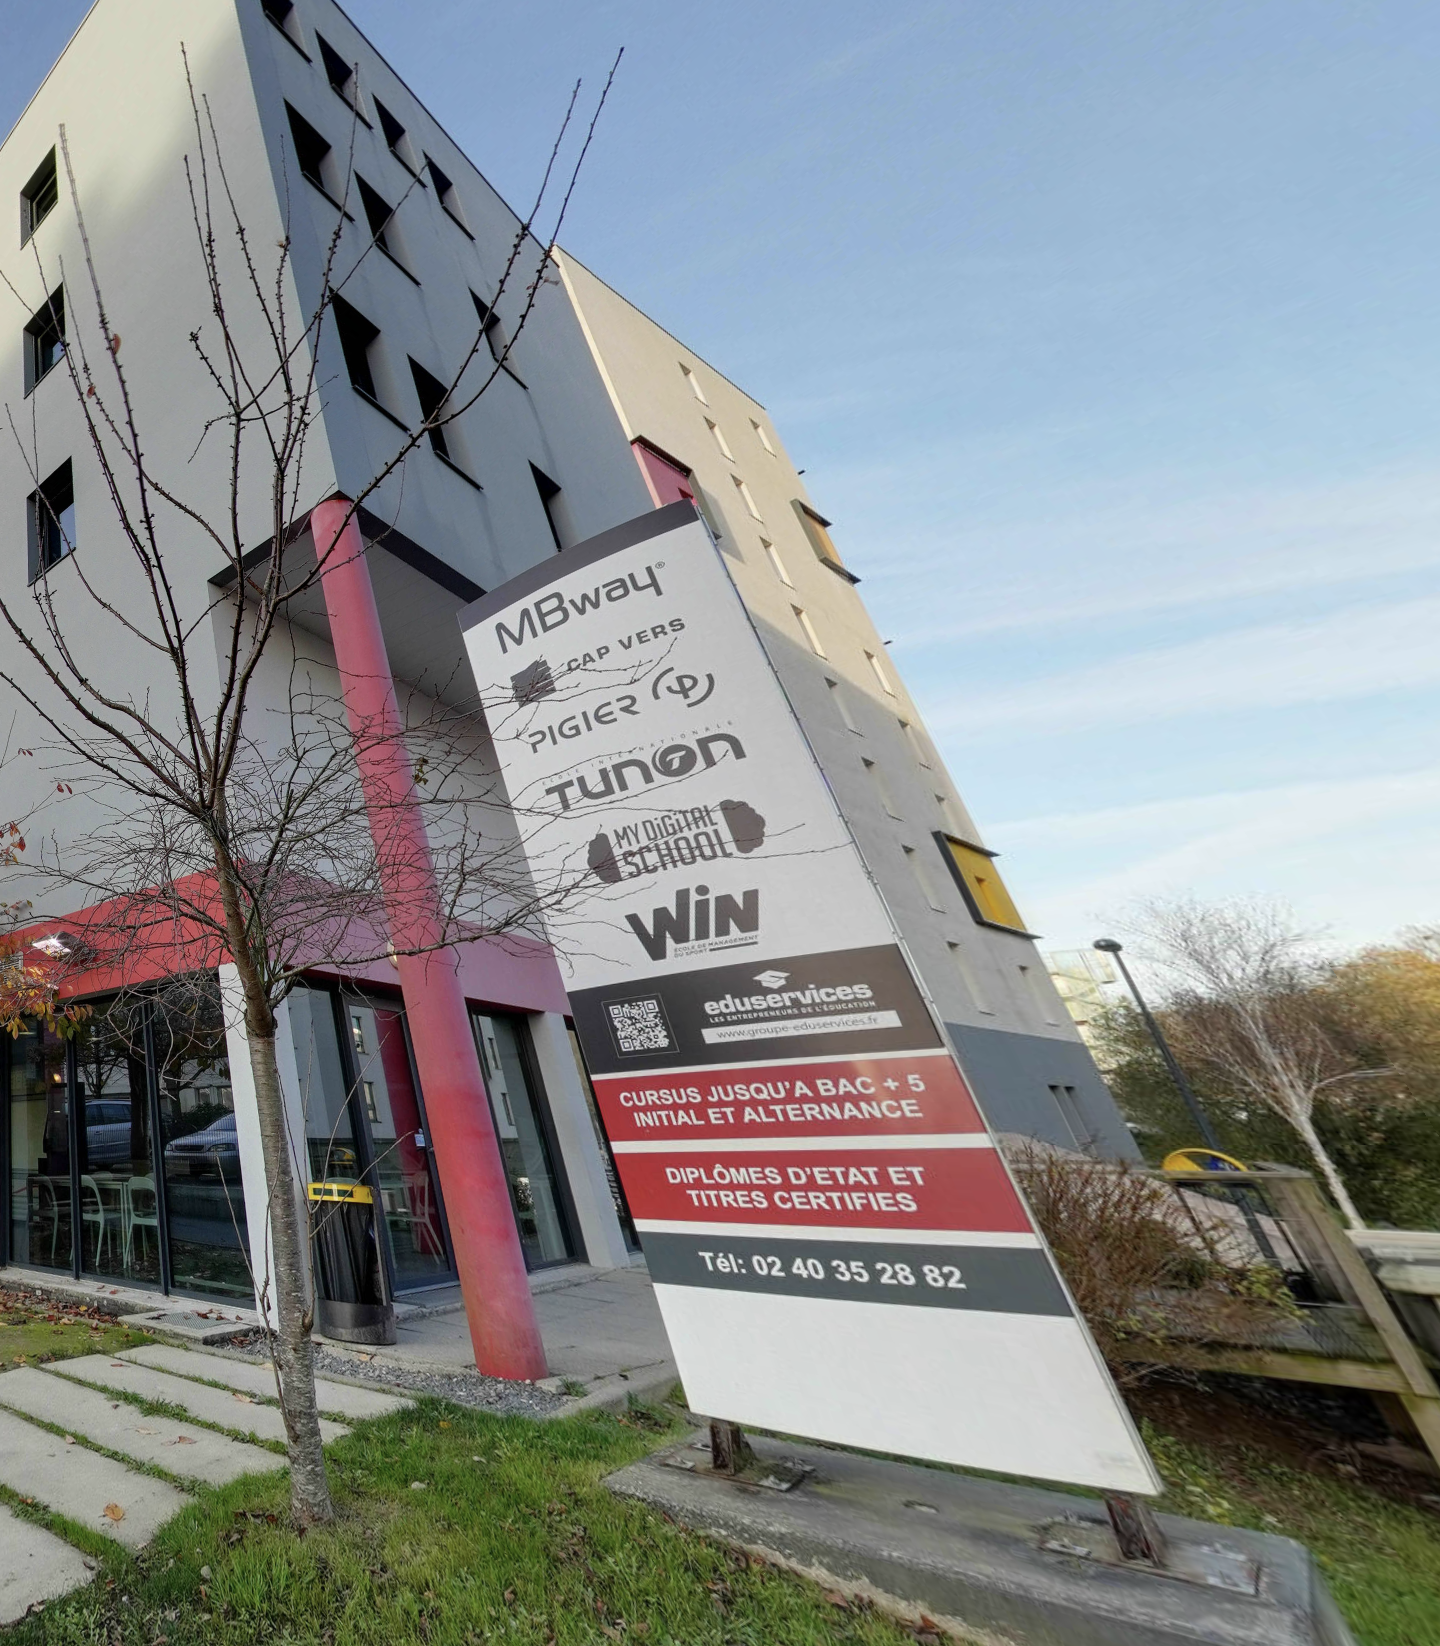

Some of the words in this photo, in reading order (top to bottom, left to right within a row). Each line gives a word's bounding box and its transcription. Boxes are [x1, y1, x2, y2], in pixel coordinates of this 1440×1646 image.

[566, 645, 610, 671] CAP
[618, 618, 686, 650] VERS
[528, 694, 641, 753] PIGIER
[613, 823, 642, 849] MY
[622, 828, 733, 878] SCHOOL
[704, 983, 873, 1016] eduservices
[710, 1016, 725, 1024] LES
[727, 1008, 798, 1022] ENTREPRENEURS
[801, 1006, 813, 1014] DE
[716, 1014, 879, 1039] www.groupe-eduservices.fr
[619, 1087, 702, 1108] CURSUS
[708, 1080, 813, 1103] JUSQU'A
[818, 1076, 876, 1097] BAC
[907, 1074, 926, 1093] 5
[634, 1109, 705, 1128] INITIAL
[708, 1107, 736, 1125] ET
[743, 1099, 924, 1124] ALTERNANCE
[665, 1163, 782, 1185] DIPLÔMES
[787, 1166, 879, 1186] D'ETAT
[887, 1166, 925, 1187] ET
[686, 1189, 768, 1209] TITRES
[773, 1190, 918, 1212] CERTIFIES
[698, 1251, 747, 1275] Tél:
[751, 1255, 786, 1278] 02
[791, 1257, 825, 1280] 40
[831, 1259, 870, 1283] 35
[875, 1261, 916, 1286] 28
[922, 1264, 967, 1289] 82
